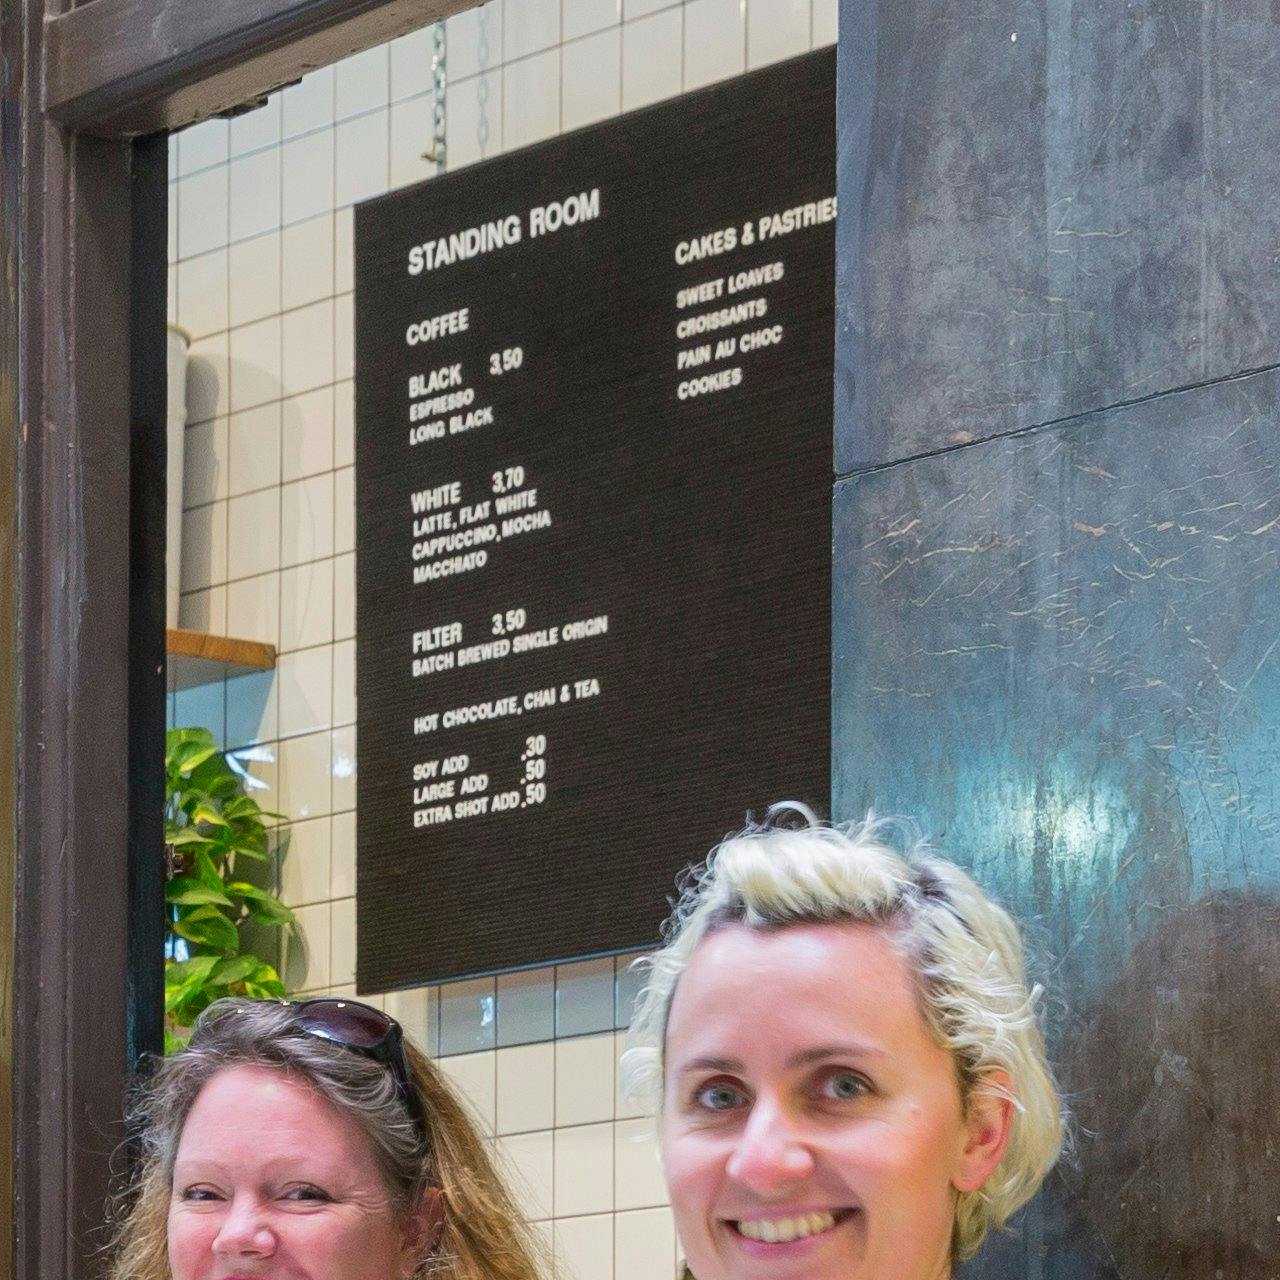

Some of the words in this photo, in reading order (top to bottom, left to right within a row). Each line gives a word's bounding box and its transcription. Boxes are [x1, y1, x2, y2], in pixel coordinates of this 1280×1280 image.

[408, 214, 521, 275] STANDING
[530, 188, 600, 238] ROOM
[675, 228, 737, 265] CAKES
[741, 223, 754, 246] &
[676, 280, 723, 308] SWEET
[728, 262, 784, 294] LOAVES
[407, 309, 469, 345] COFFEE
[677, 298, 767, 339] CROISSANTS
[677, 343, 711, 370] PAIN
[715, 339, 736, 360] AU
[740, 325, 783, 354] CHOC
[409, 363, 462, 398] BLACK
[678, 368, 742, 399] COOKIES
[410, 389, 474, 421] ESPRESSO
[410, 421, 445, 445] LONG
[450, 407, 493, 433] BLACK
[411, 482, 461, 513] WHITE
[460, 500, 490, 526] FLAT
[496, 489, 537, 517] WHITE
[502, 510, 551, 536] MOCHA
[413, 550, 487, 584] MACCHIATO
[413, 622, 462, 653] FILTER
[413, 652, 454, 676] BATCH
[458, 639, 509, 667] BREWED
[513, 627, 558, 652] SINGLE
[563, 616, 607, 641] ORIGIN
[414, 714, 438, 735] HOT
[524, 687, 556, 710] CHAI
[560, 684, 571, 703] &
[574, 679, 600, 699] TEA
[413, 761, 439, 780] SOY
[442, 755, 469, 775] ADD
[413, 781, 455, 804] LARGE
[461, 775, 488, 794] ADD
[414, 806, 452, 828] EXTRA
[455, 798, 488, 821] SHOT
[492, 791, 520, 813] ADD
